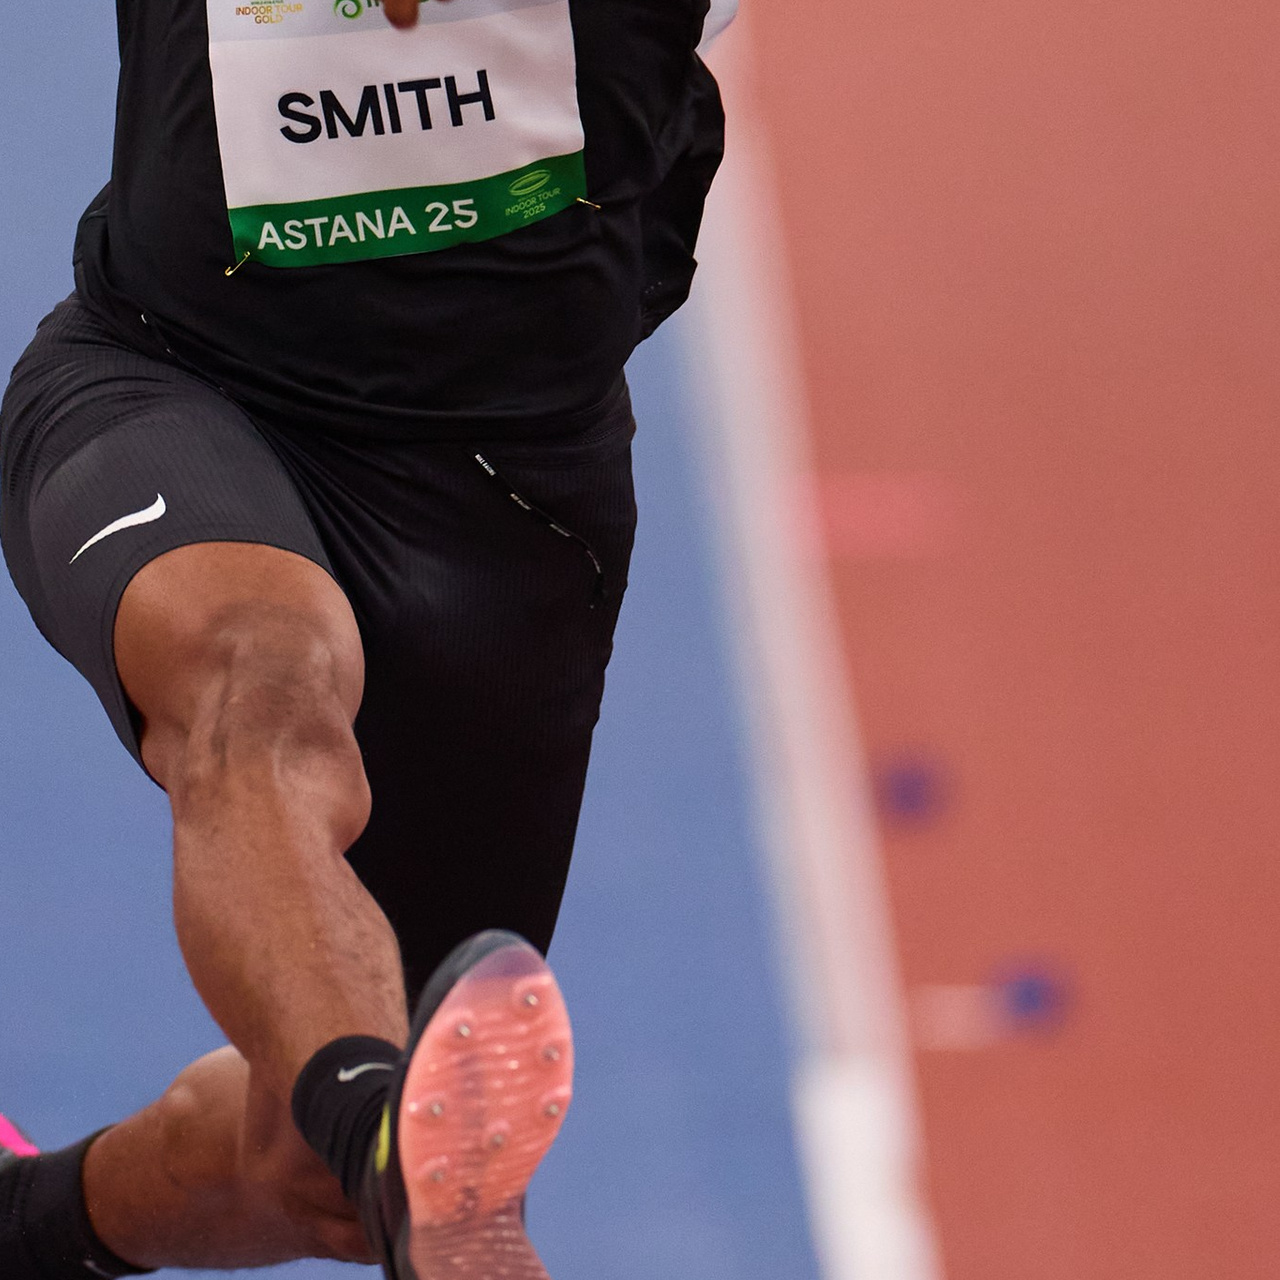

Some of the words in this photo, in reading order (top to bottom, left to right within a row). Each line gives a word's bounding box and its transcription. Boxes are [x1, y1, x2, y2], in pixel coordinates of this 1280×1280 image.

[235, 5, 273, 16] INDOOR
[275, 2, 303, 14] TOUR
[254, 15, 284, 25] GOLD
[277, 69, 496, 144] SMITH
[505, 197, 537, 216] INDOOR
[538, 187, 561, 202] TOUR
[523, 202, 546, 219] 2025
[257, 206, 417, 251] ASTANA
[425, 198, 479, 233] 25
